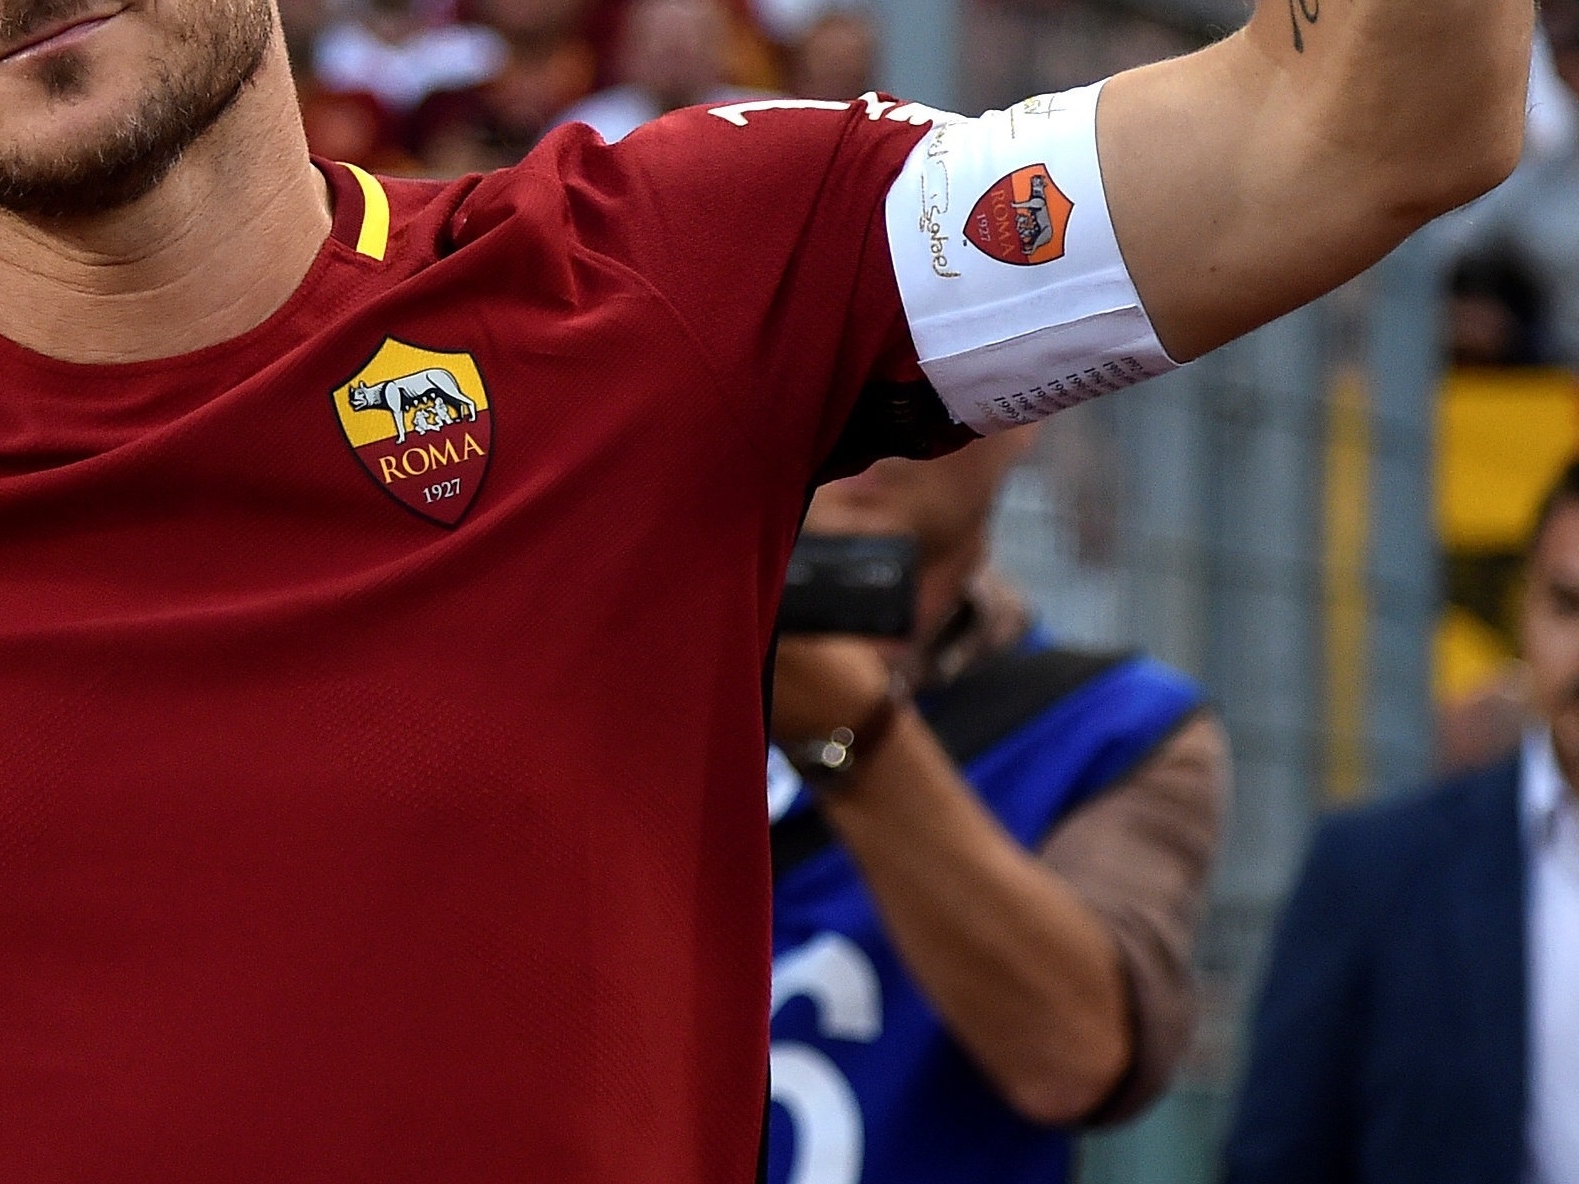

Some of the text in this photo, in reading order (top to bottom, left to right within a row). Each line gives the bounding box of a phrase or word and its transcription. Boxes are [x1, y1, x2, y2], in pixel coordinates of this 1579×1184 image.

[975, 213, 992, 243] 1927
[989, 188, 1016, 257] ROMA
[378, 431, 486, 484] ROMA
[422, 477, 461, 504] 1927
